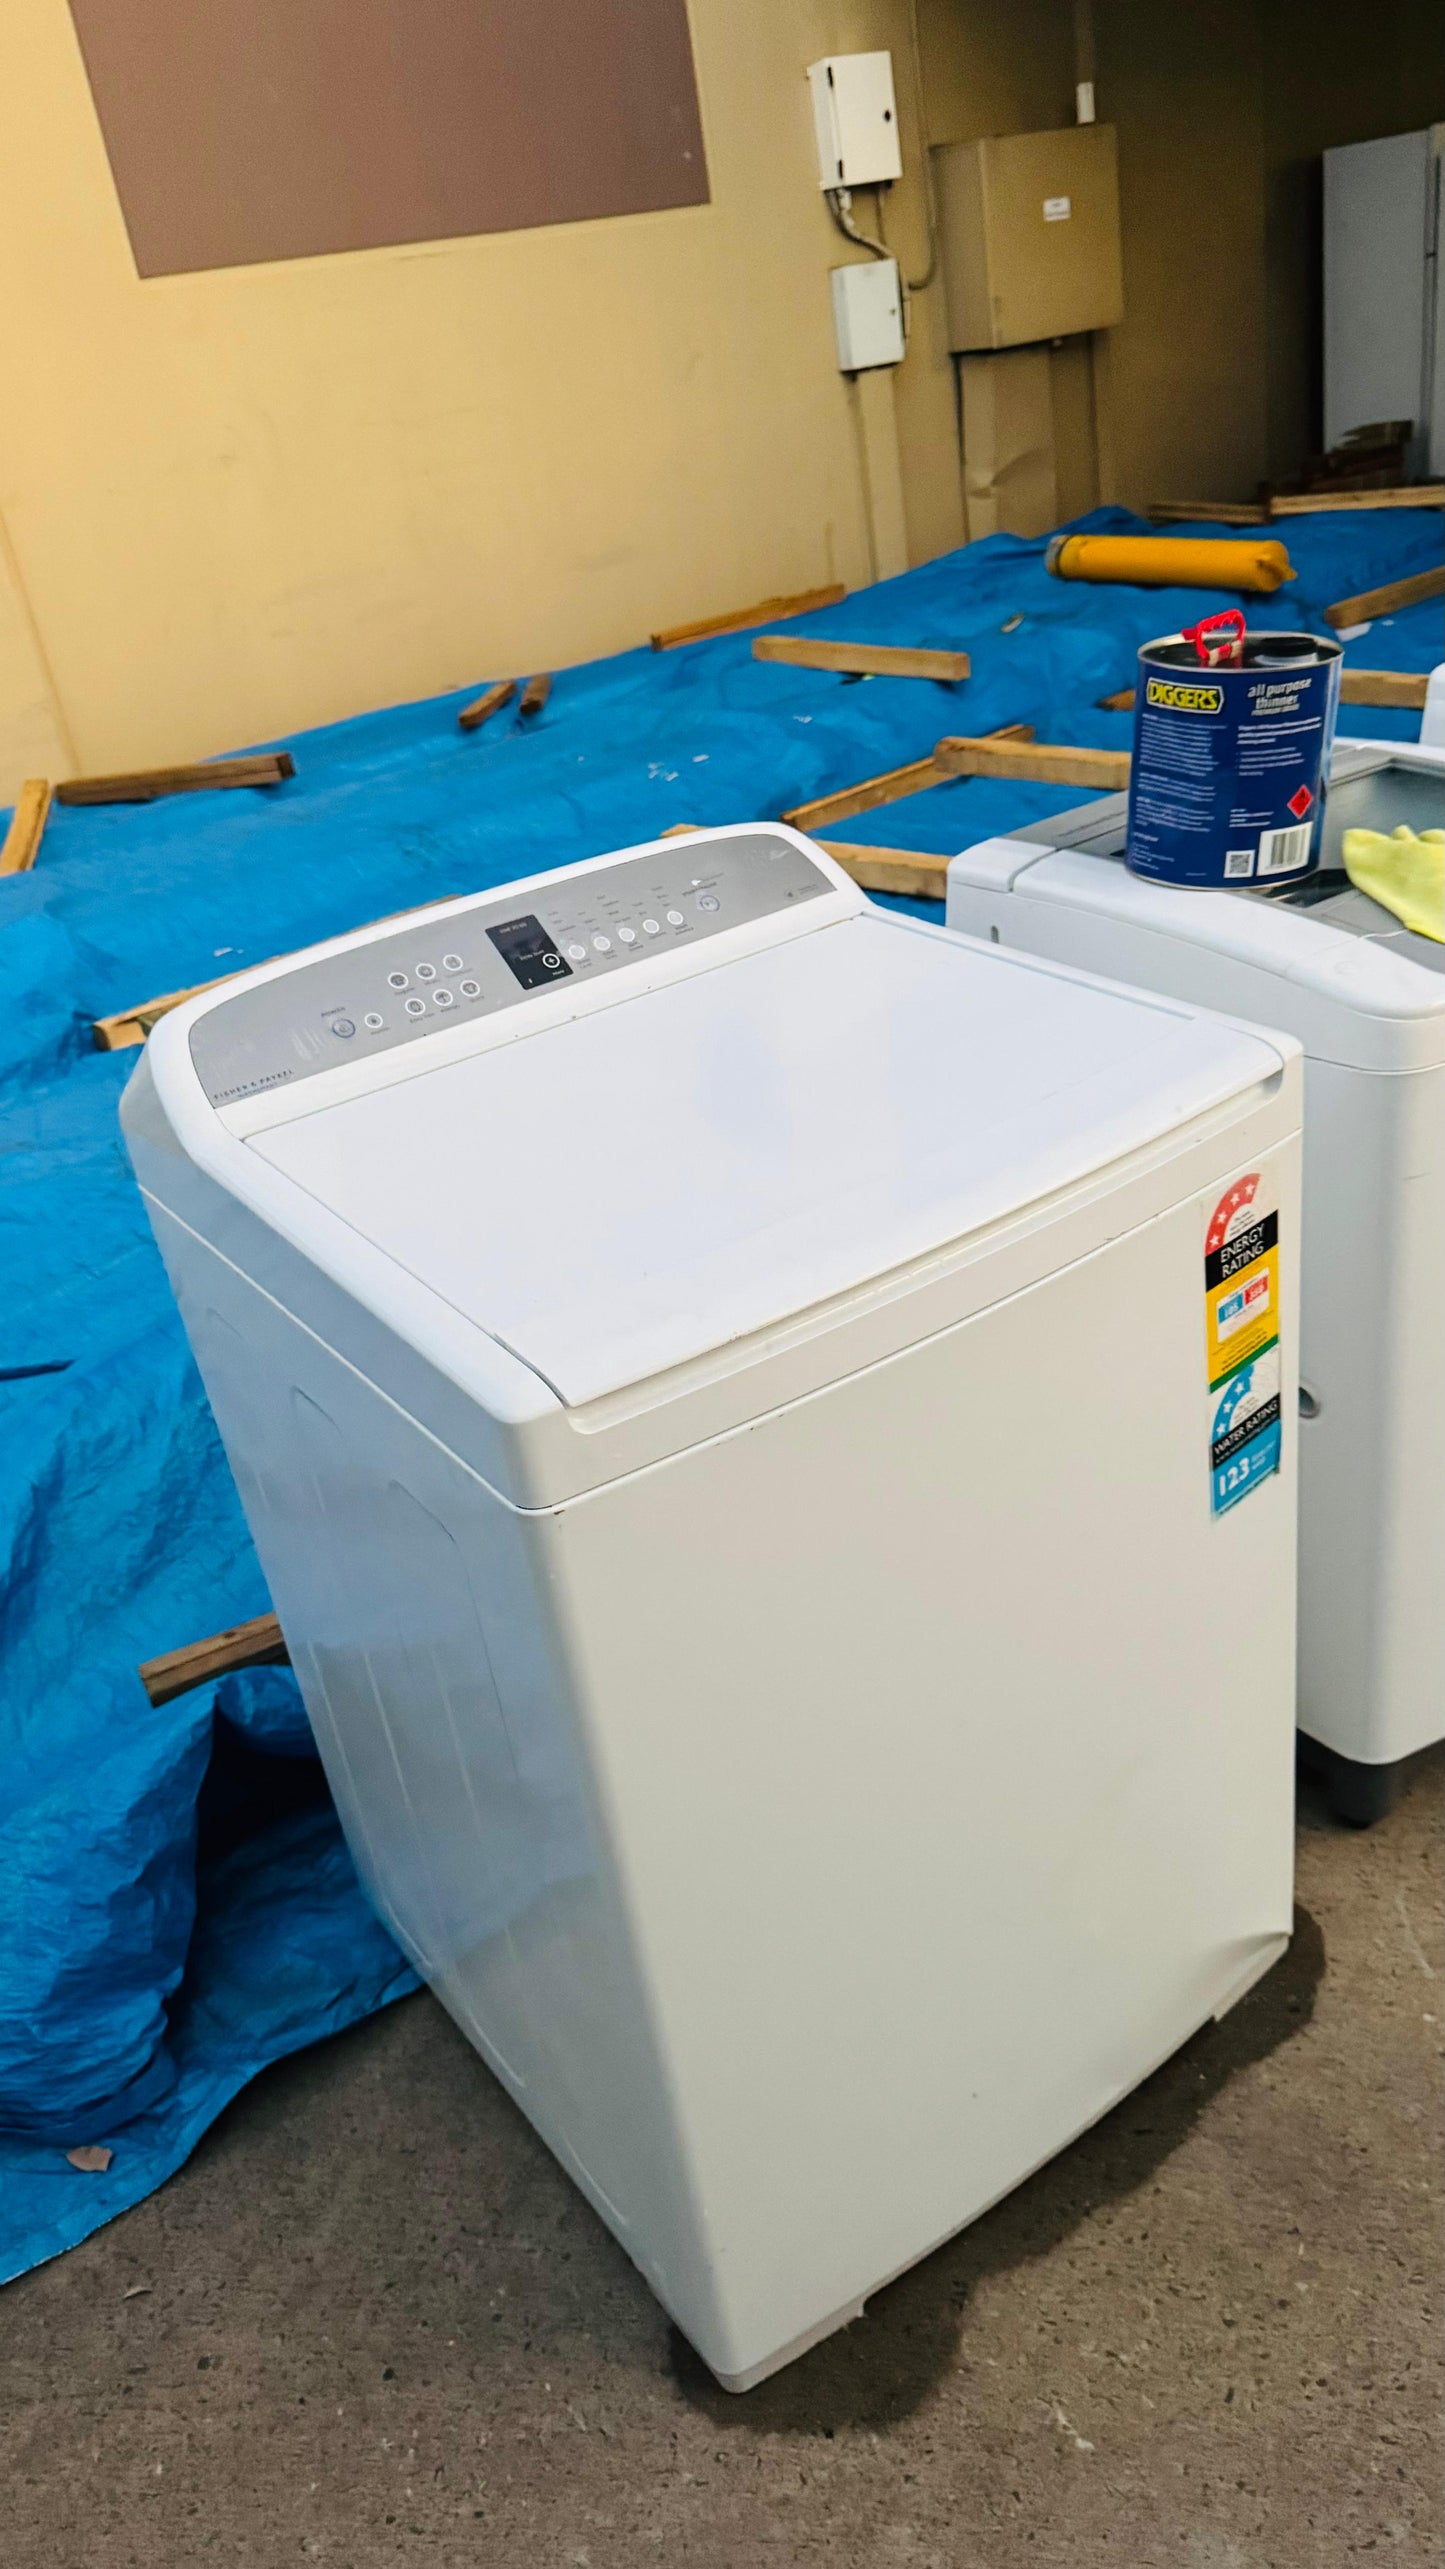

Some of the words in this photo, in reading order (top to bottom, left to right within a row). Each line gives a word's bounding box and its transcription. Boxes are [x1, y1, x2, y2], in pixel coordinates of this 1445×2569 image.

[1149, 682, 1218, 709] DIGGERS
[1247, 684, 1266, 698] all
[1266, 678, 1312, 699] purpose
[1255, 695, 1299, 710] thinner
[1220, 1223, 1265, 1264] ENERGY
[1222, 1240, 1264, 1279] RATING
[1214, 1426, 1246, 1455] WATER
[1245, 1399, 1278, 1432] RATING
[1219, 1457, 1250, 1497] 123
